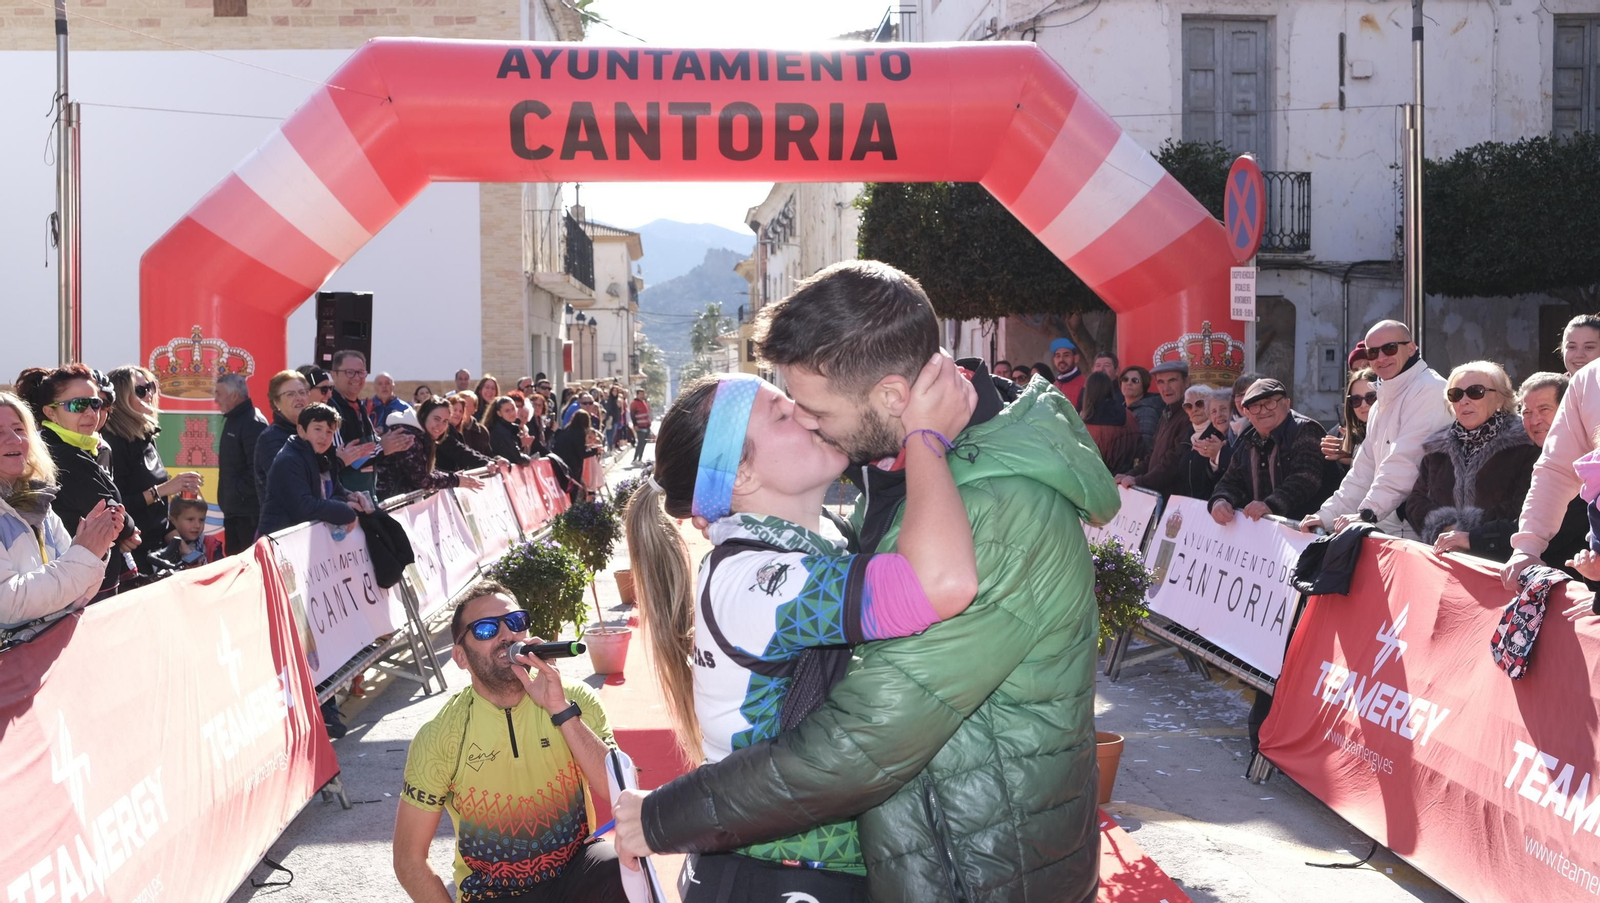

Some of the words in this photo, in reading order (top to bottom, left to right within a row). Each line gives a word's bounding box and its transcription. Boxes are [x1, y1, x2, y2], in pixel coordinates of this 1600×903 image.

[496, 48, 912, 82] AYUNTAMIENTO
[509, 99, 899, 162] CANTORIA
[1169, 552, 1288, 636] CANTORIA
[1184, 531, 1275, 579] AYUNTAMIENTO
[201, 665, 294, 770] TEAMERG
[1312, 660, 1450, 746] TEAMERGY
[1504, 739, 1600, 838] TEAM
[6, 765, 169, 903] TEAMERGY
